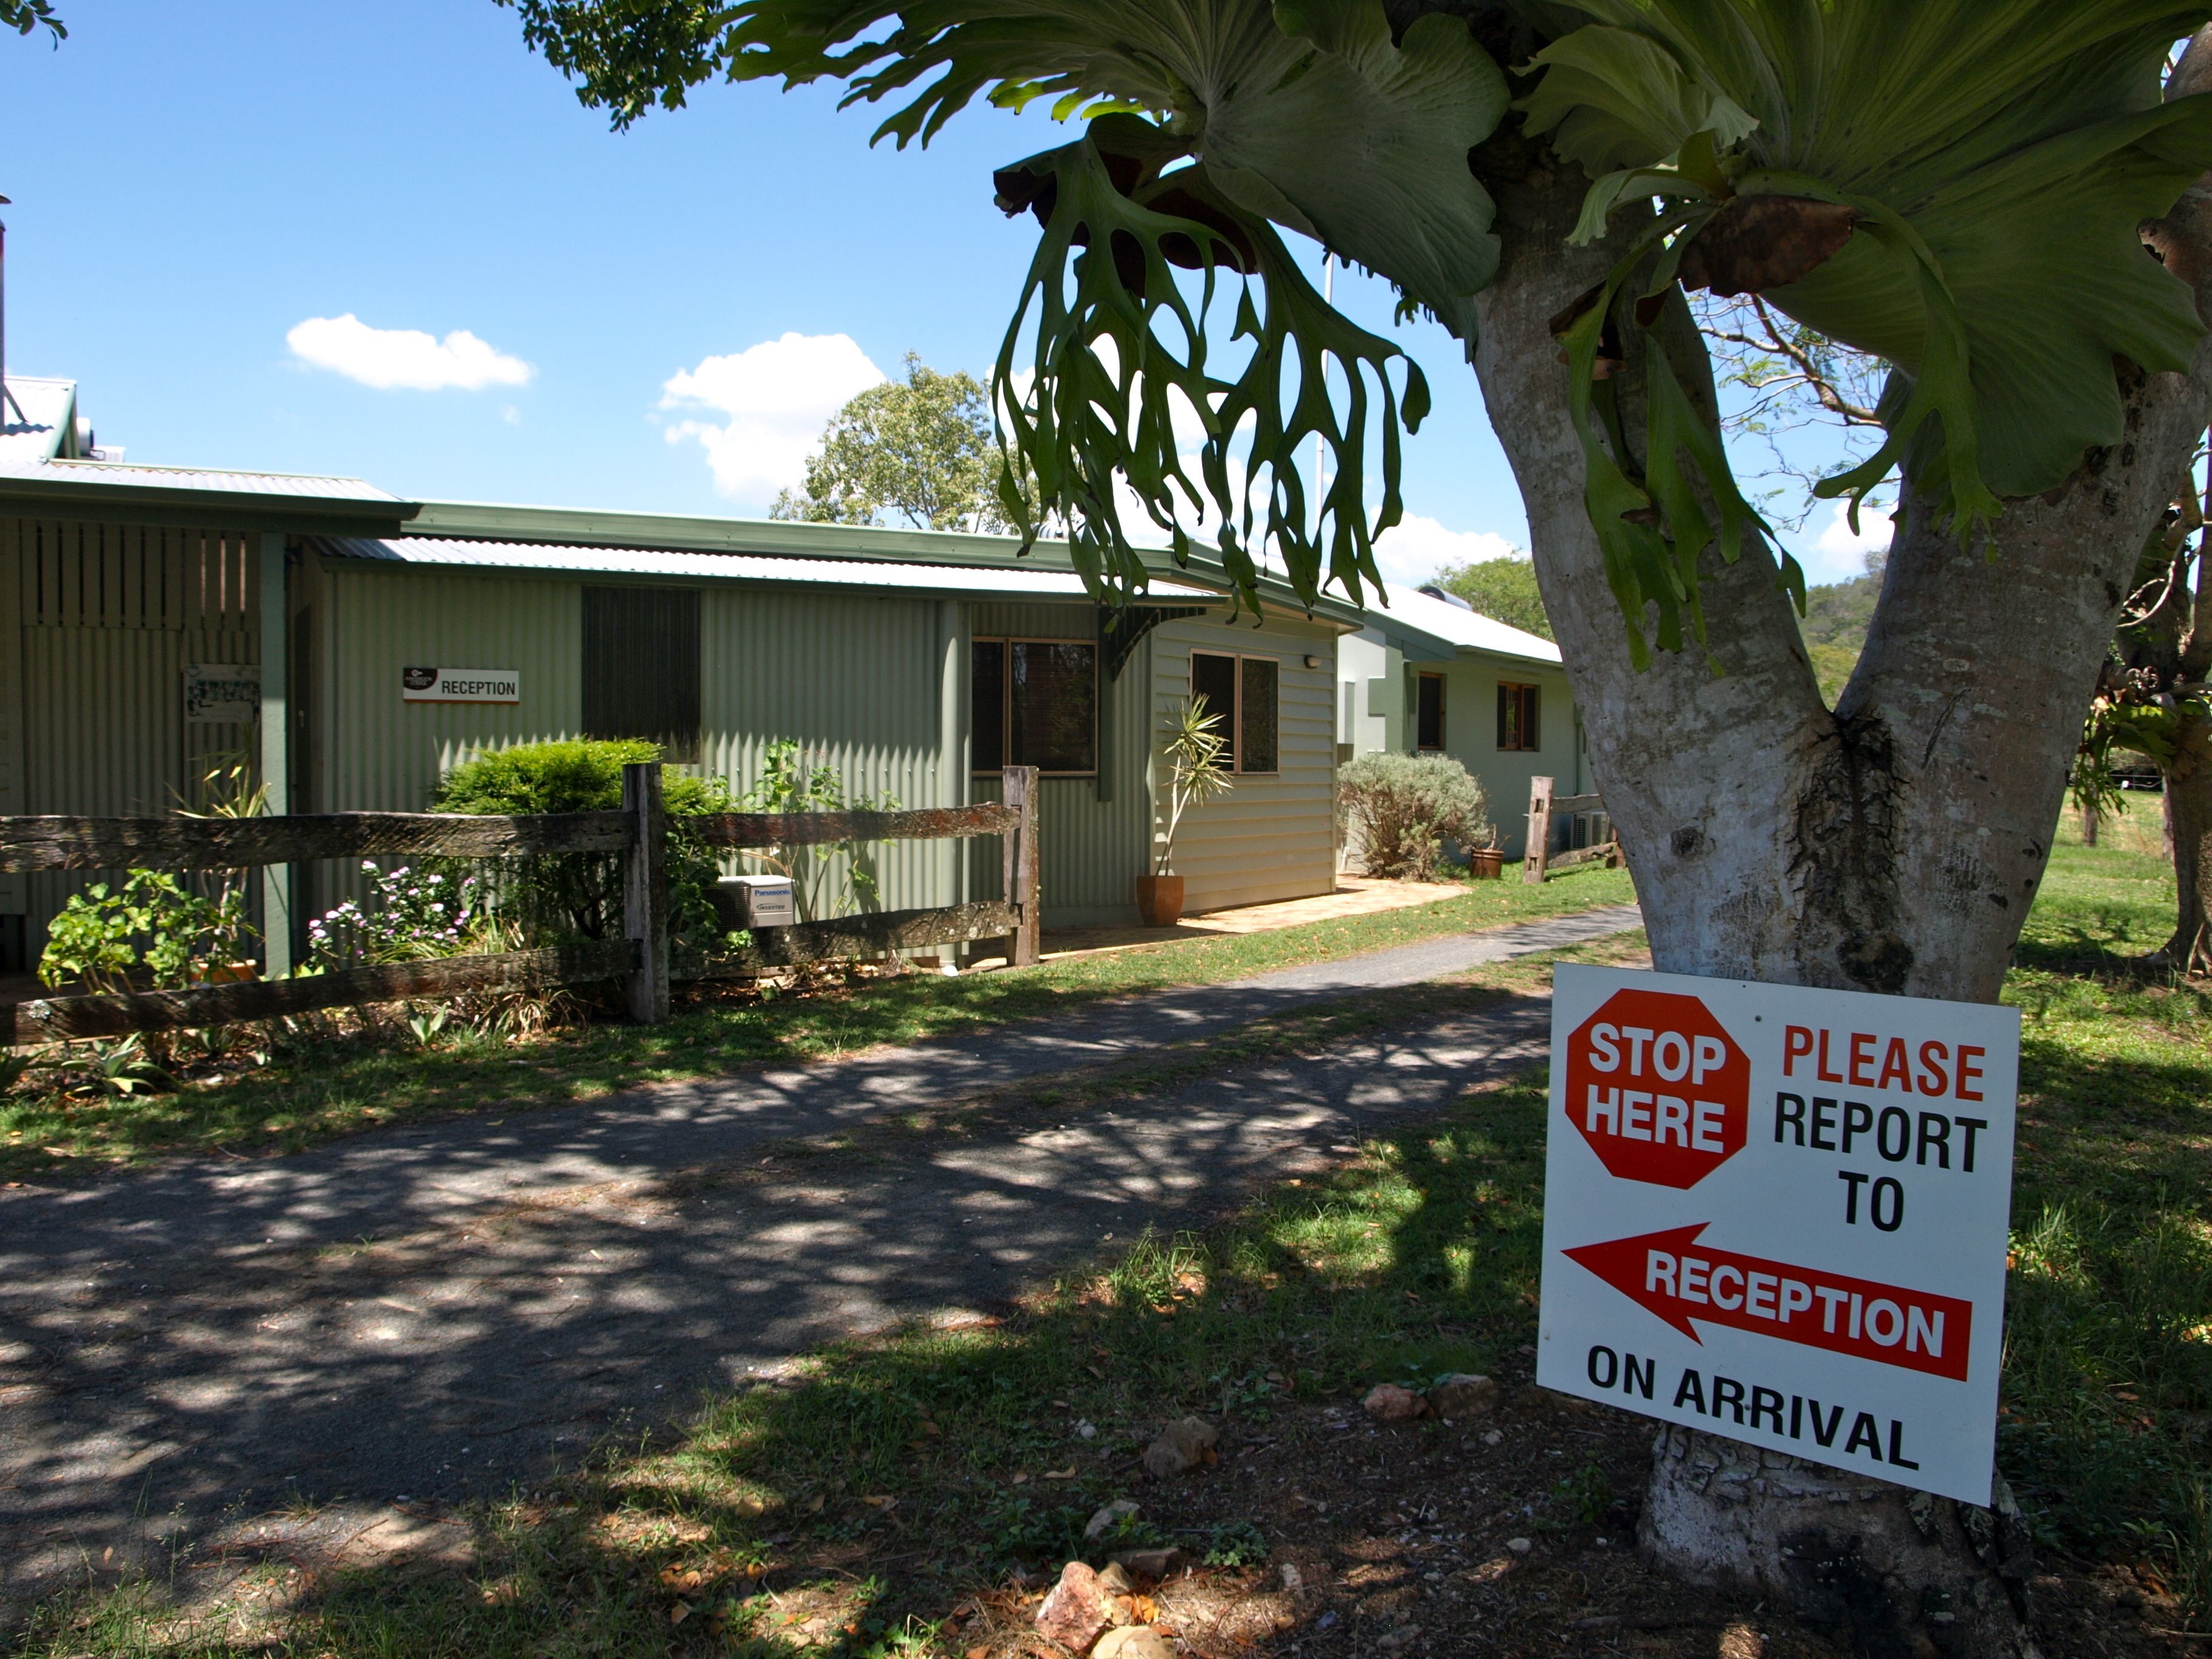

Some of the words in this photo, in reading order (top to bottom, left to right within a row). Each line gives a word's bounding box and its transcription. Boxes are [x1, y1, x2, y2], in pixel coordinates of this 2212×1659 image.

[442, 681, 515, 695] RECEPTION
[1589, 1022, 1726, 1085] STOP
[1783, 1025, 1986, 1102] PLEASE
[1586, 1085, 1724, 1154] HERE
[1774, 1091, 1988, 1173] REPORT
[1838, 1170, 1905, 1232] TO
[1646, 1249, 1945, 1358] RECEPTION
[1587, 1345, 1655, 1400] ON
[1673, 1369, 1919, 1471] ARRIVAL
